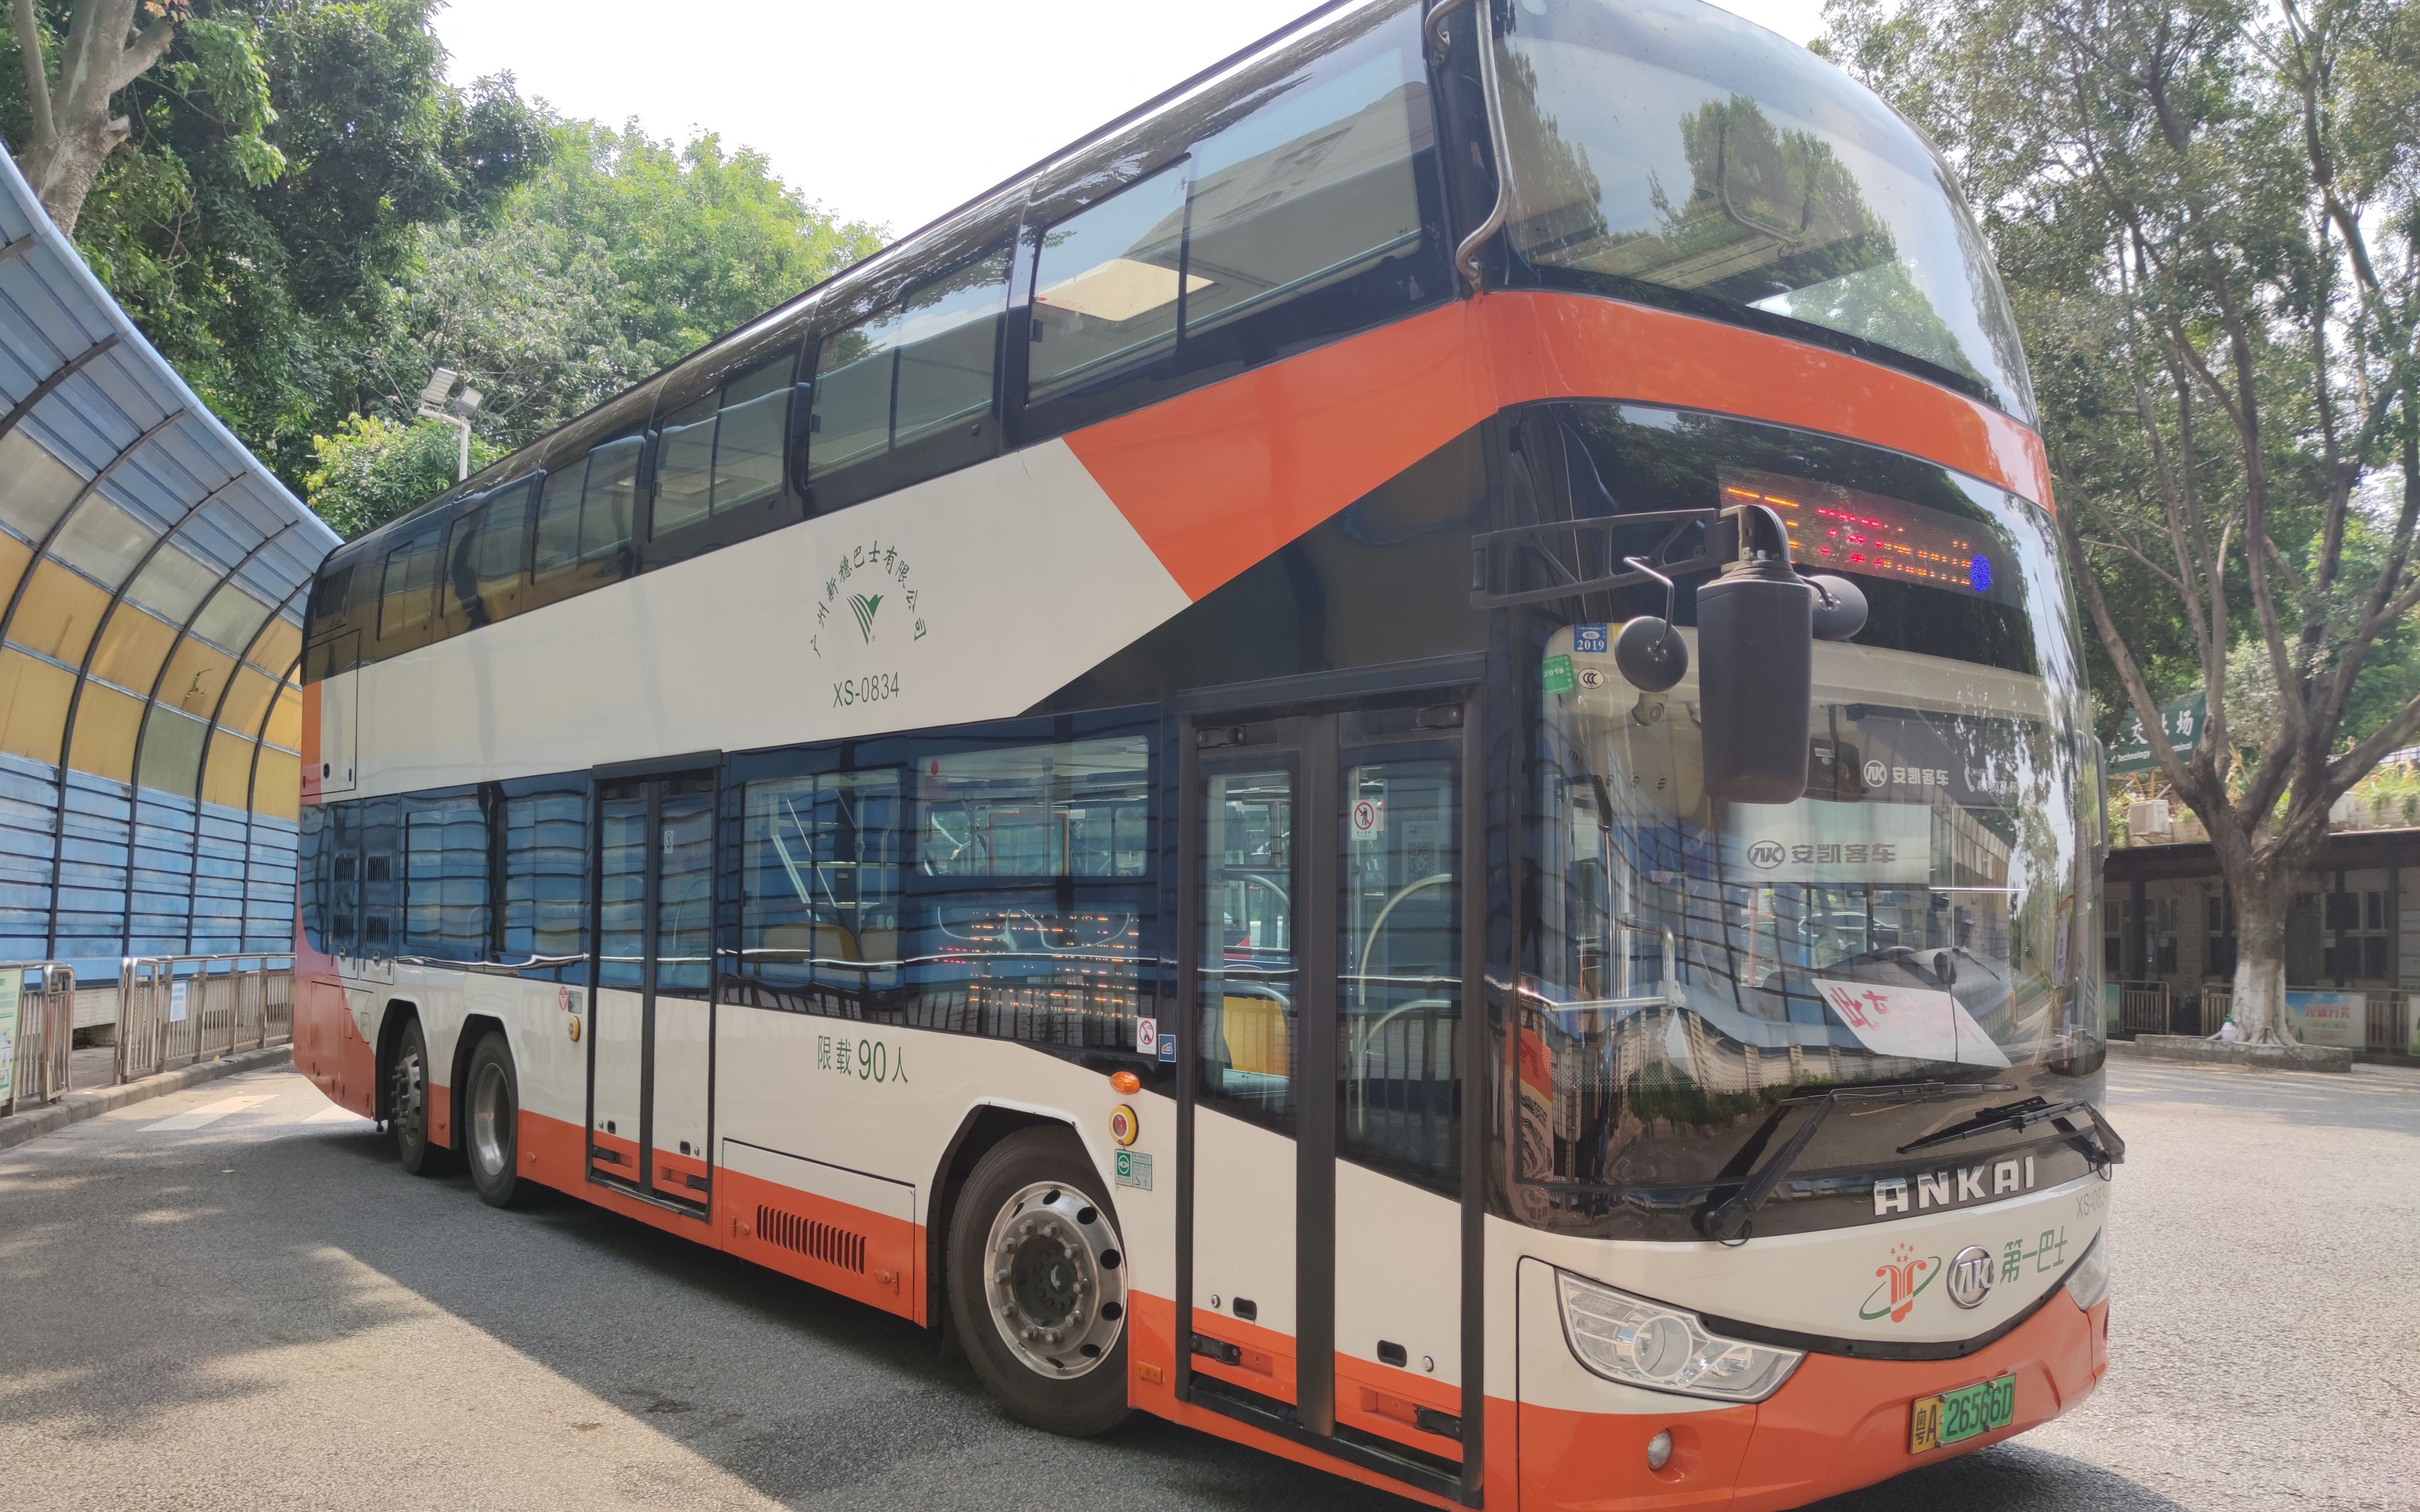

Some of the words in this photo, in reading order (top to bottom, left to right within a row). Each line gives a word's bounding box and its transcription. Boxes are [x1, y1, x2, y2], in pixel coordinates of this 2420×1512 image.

[810, 540, 926, 660] 广州新穗巴士有限公司
[1577, 640, 1604, 650] 2019
[833, 672, 899, 708] XS-0834
[1544, 668, 1564, 677] 2018
[1892, 766, 1948, 786] 安凯客车
[1791, 844, 1896, 864] 安凯客车
[817, 1035, 908, 1084] 限载90人
[1874, 1156, 2035, 1216] ANKAI
[2000, 1226, 2067, 1285] 第一巴士
[1946, 1383, 2013, 1437] 26566D
